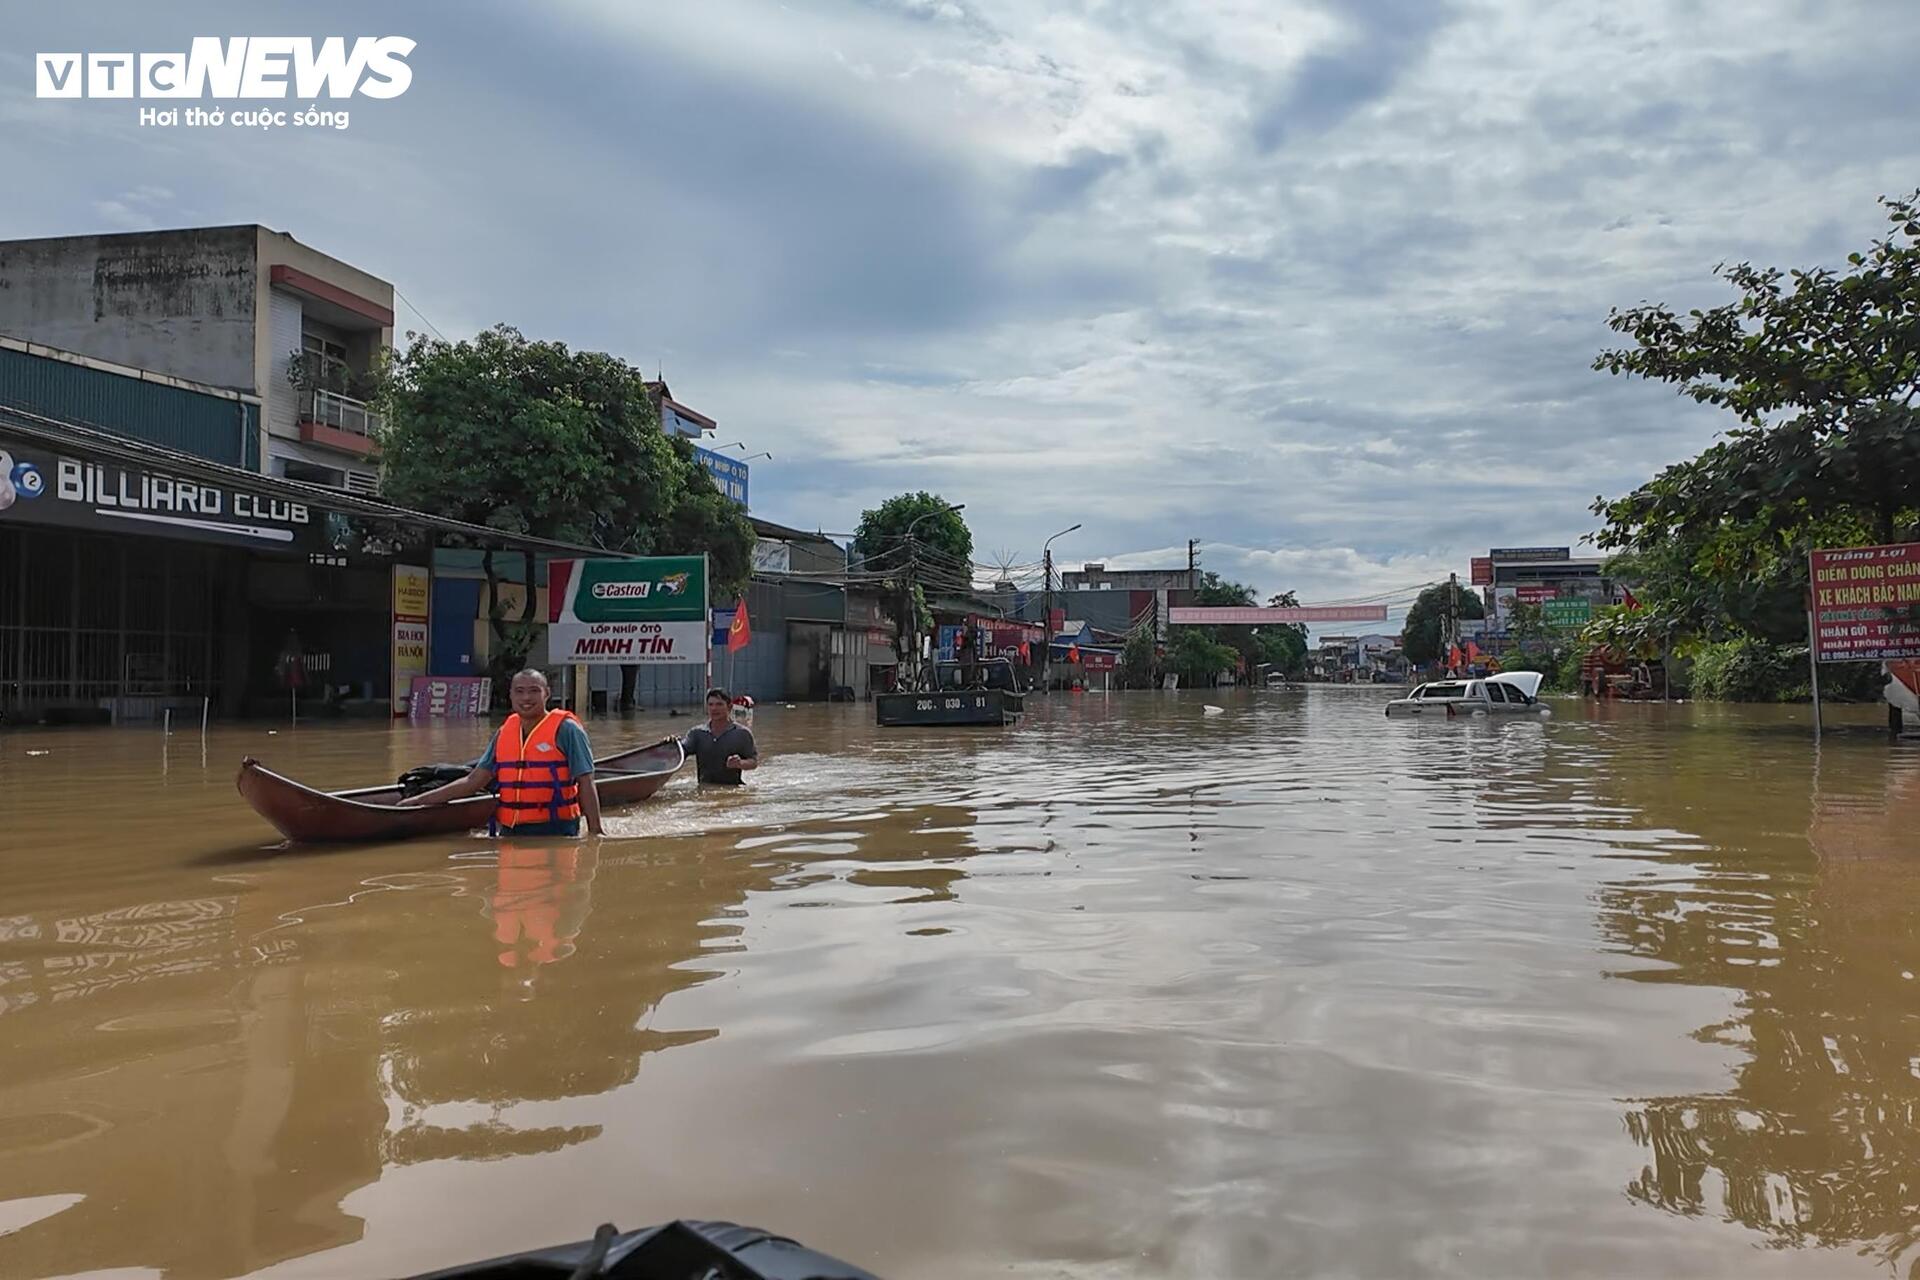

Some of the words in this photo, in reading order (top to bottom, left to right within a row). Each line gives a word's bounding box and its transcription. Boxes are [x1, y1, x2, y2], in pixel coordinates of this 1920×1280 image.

[57, 456, 222, 514] BILLIARD
[234, 492, 309, 524] CLUB
[606, 584, 647, 596] Castrol
[1819, 588, 1833, 606] XE
[1835, 584, 1871, 605] KHÁCH
[1873, 580, 1894, 603] BẮC
[398, 630, 410, 641] BIA
[591, 624, 610, 634] LỐP
[612, 624, 638, 634] NHÍP
[575, 638, 633, 654] MINH
[638, 634, 673, 654] TÍN
[428, 681, 448, 718] HỞ
[976, 697, 986, 708] 81
